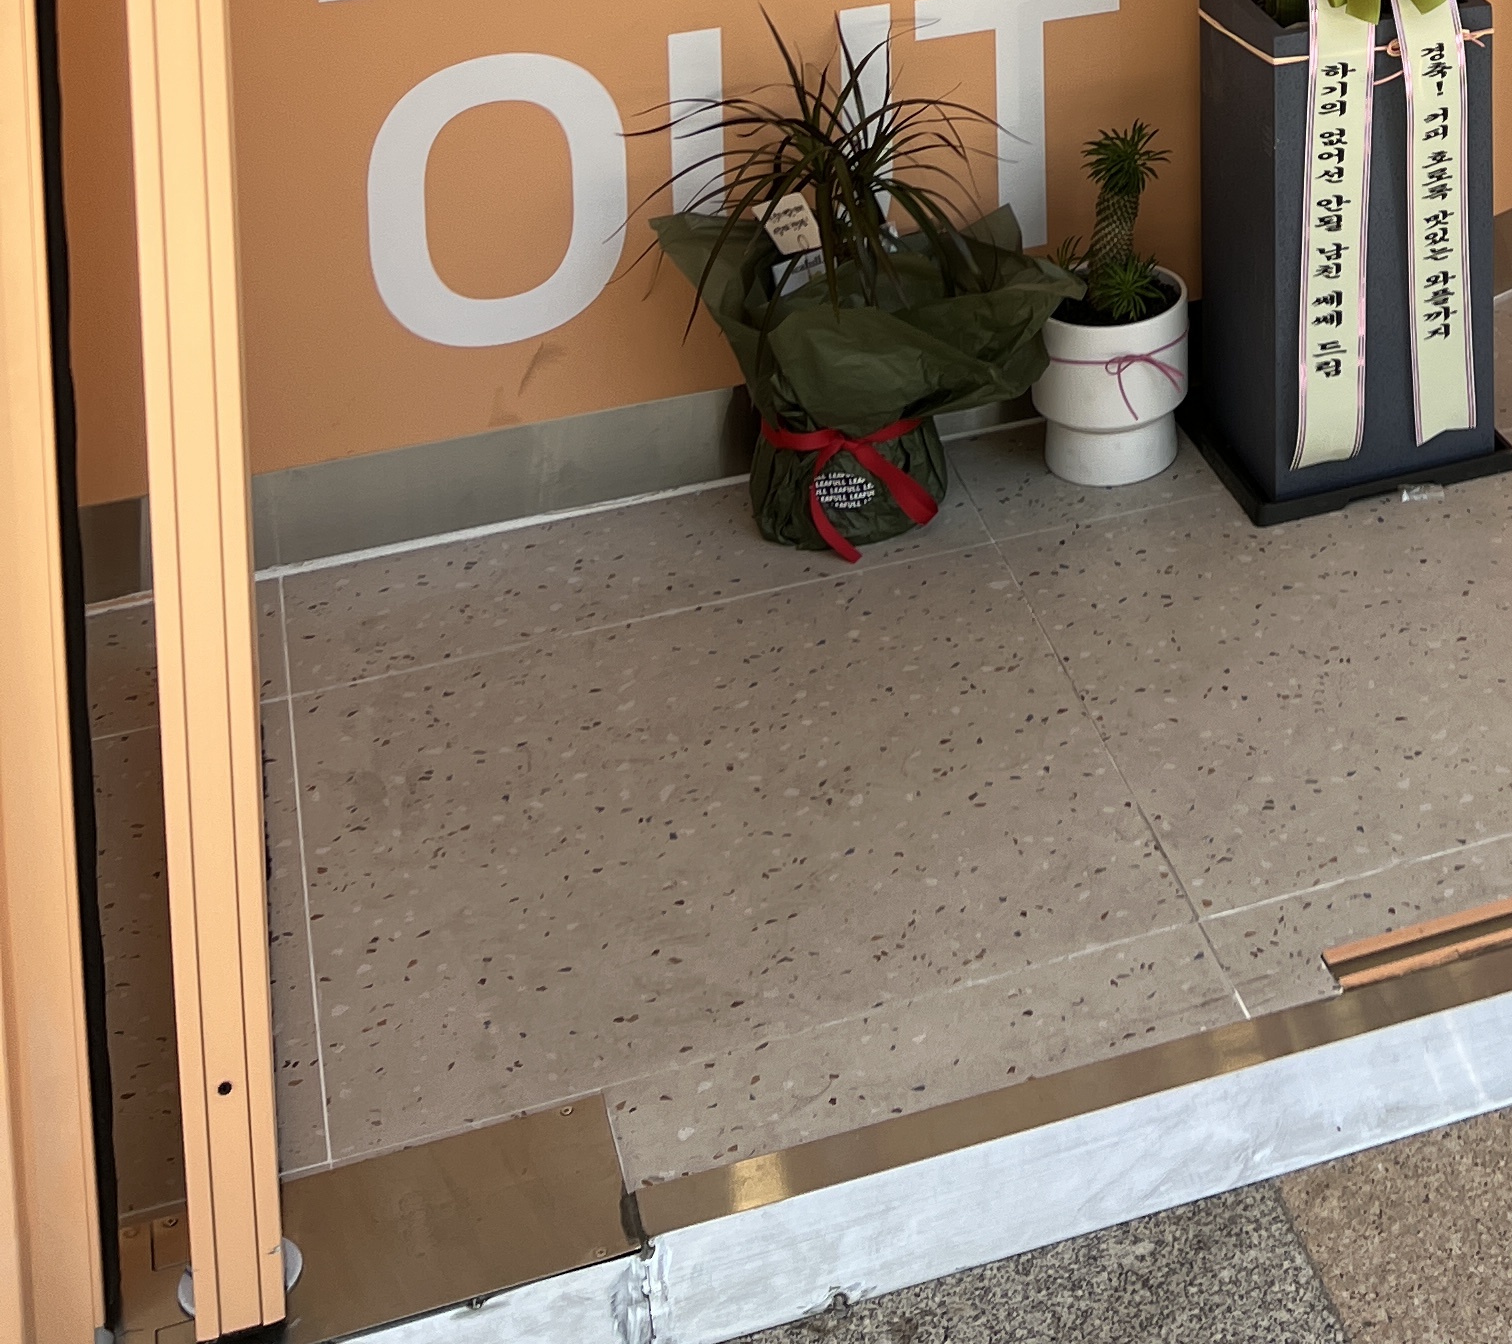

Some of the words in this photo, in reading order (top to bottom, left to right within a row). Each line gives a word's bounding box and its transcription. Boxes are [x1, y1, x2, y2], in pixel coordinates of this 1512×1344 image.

[1421, 42, 1453, 96] 경축!
[1422, 107, 1448, 141] 커피
[1315, 127, 1348, 183] 없어선
[1422, 150, 1453, 200] 호로록
[1423, 210, 1454, 261] 맛있는
[1423, 271, 1458, 340] 와플까지
[1312, 340, 1347, 379] 드림
